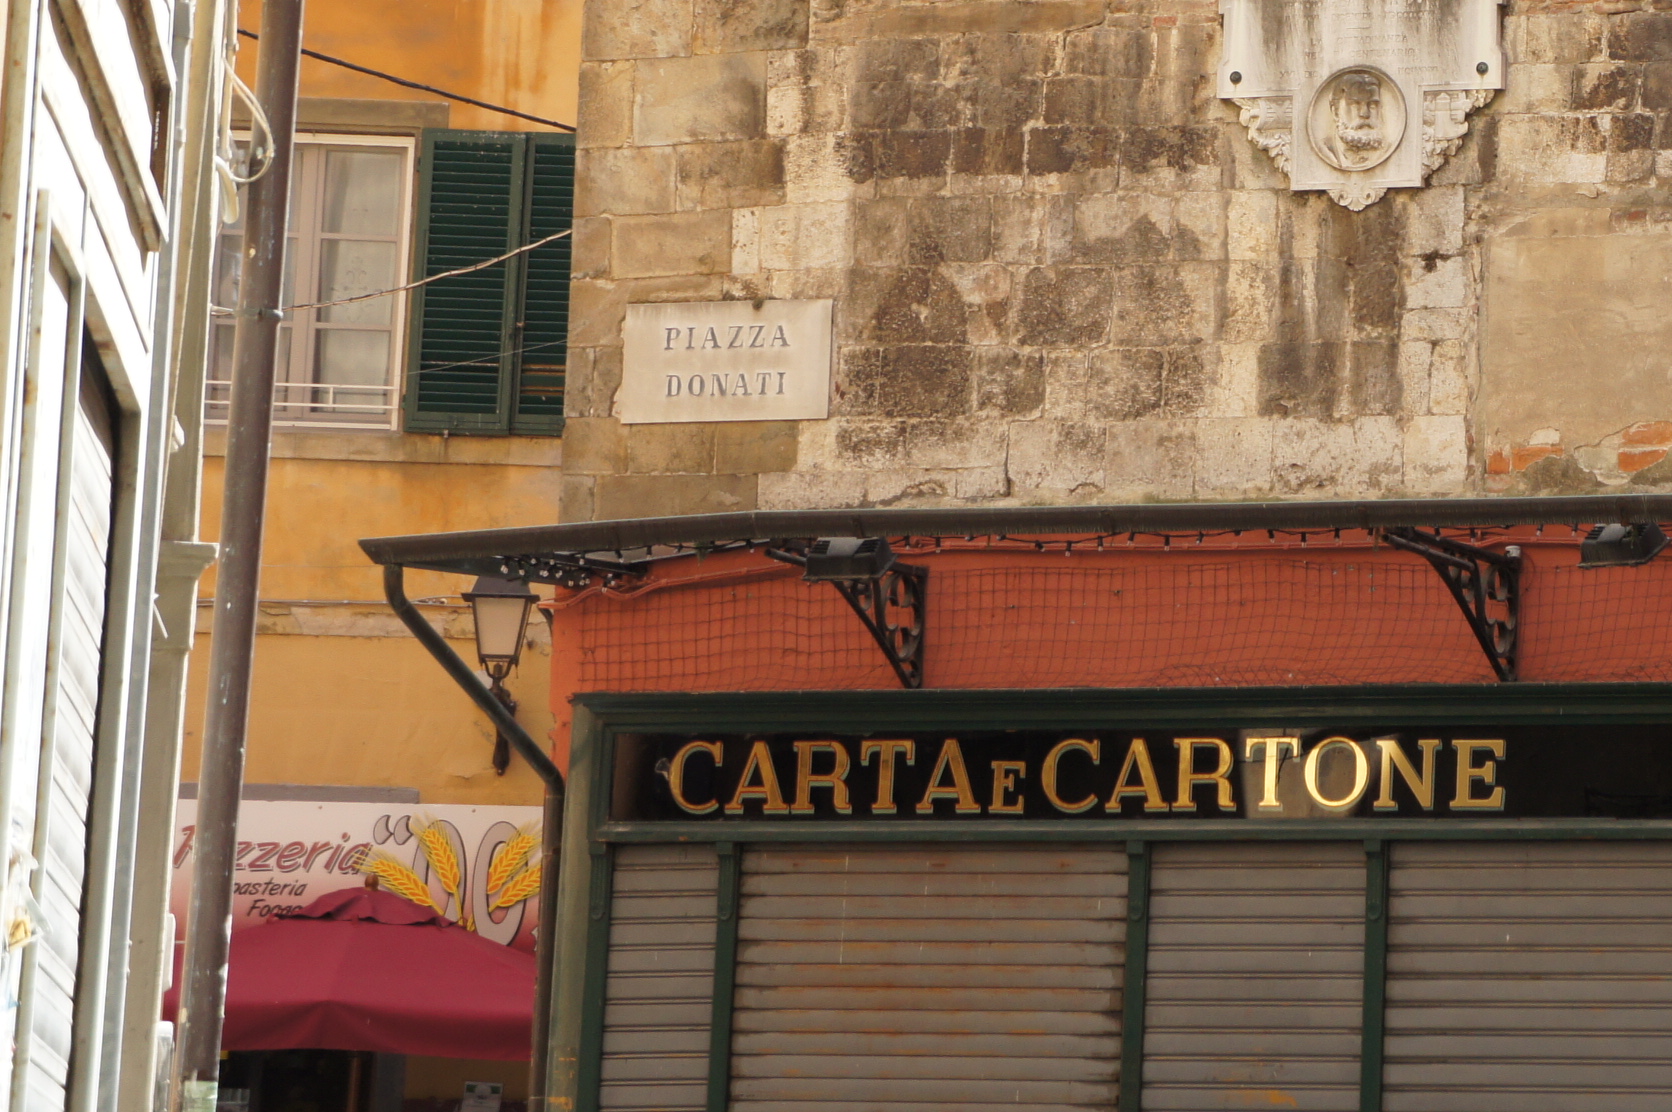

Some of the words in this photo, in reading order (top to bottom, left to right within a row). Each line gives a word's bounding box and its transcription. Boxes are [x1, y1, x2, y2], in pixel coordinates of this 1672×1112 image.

[664, 324, 790, 351] PIAZZA
[665, 372, 787, 398] DONATI
[668, 738, 982, 814] CARTA
[1040, 736, 1507, 814] CARTONE
[173, 824, 373, 875] Pzzeria
